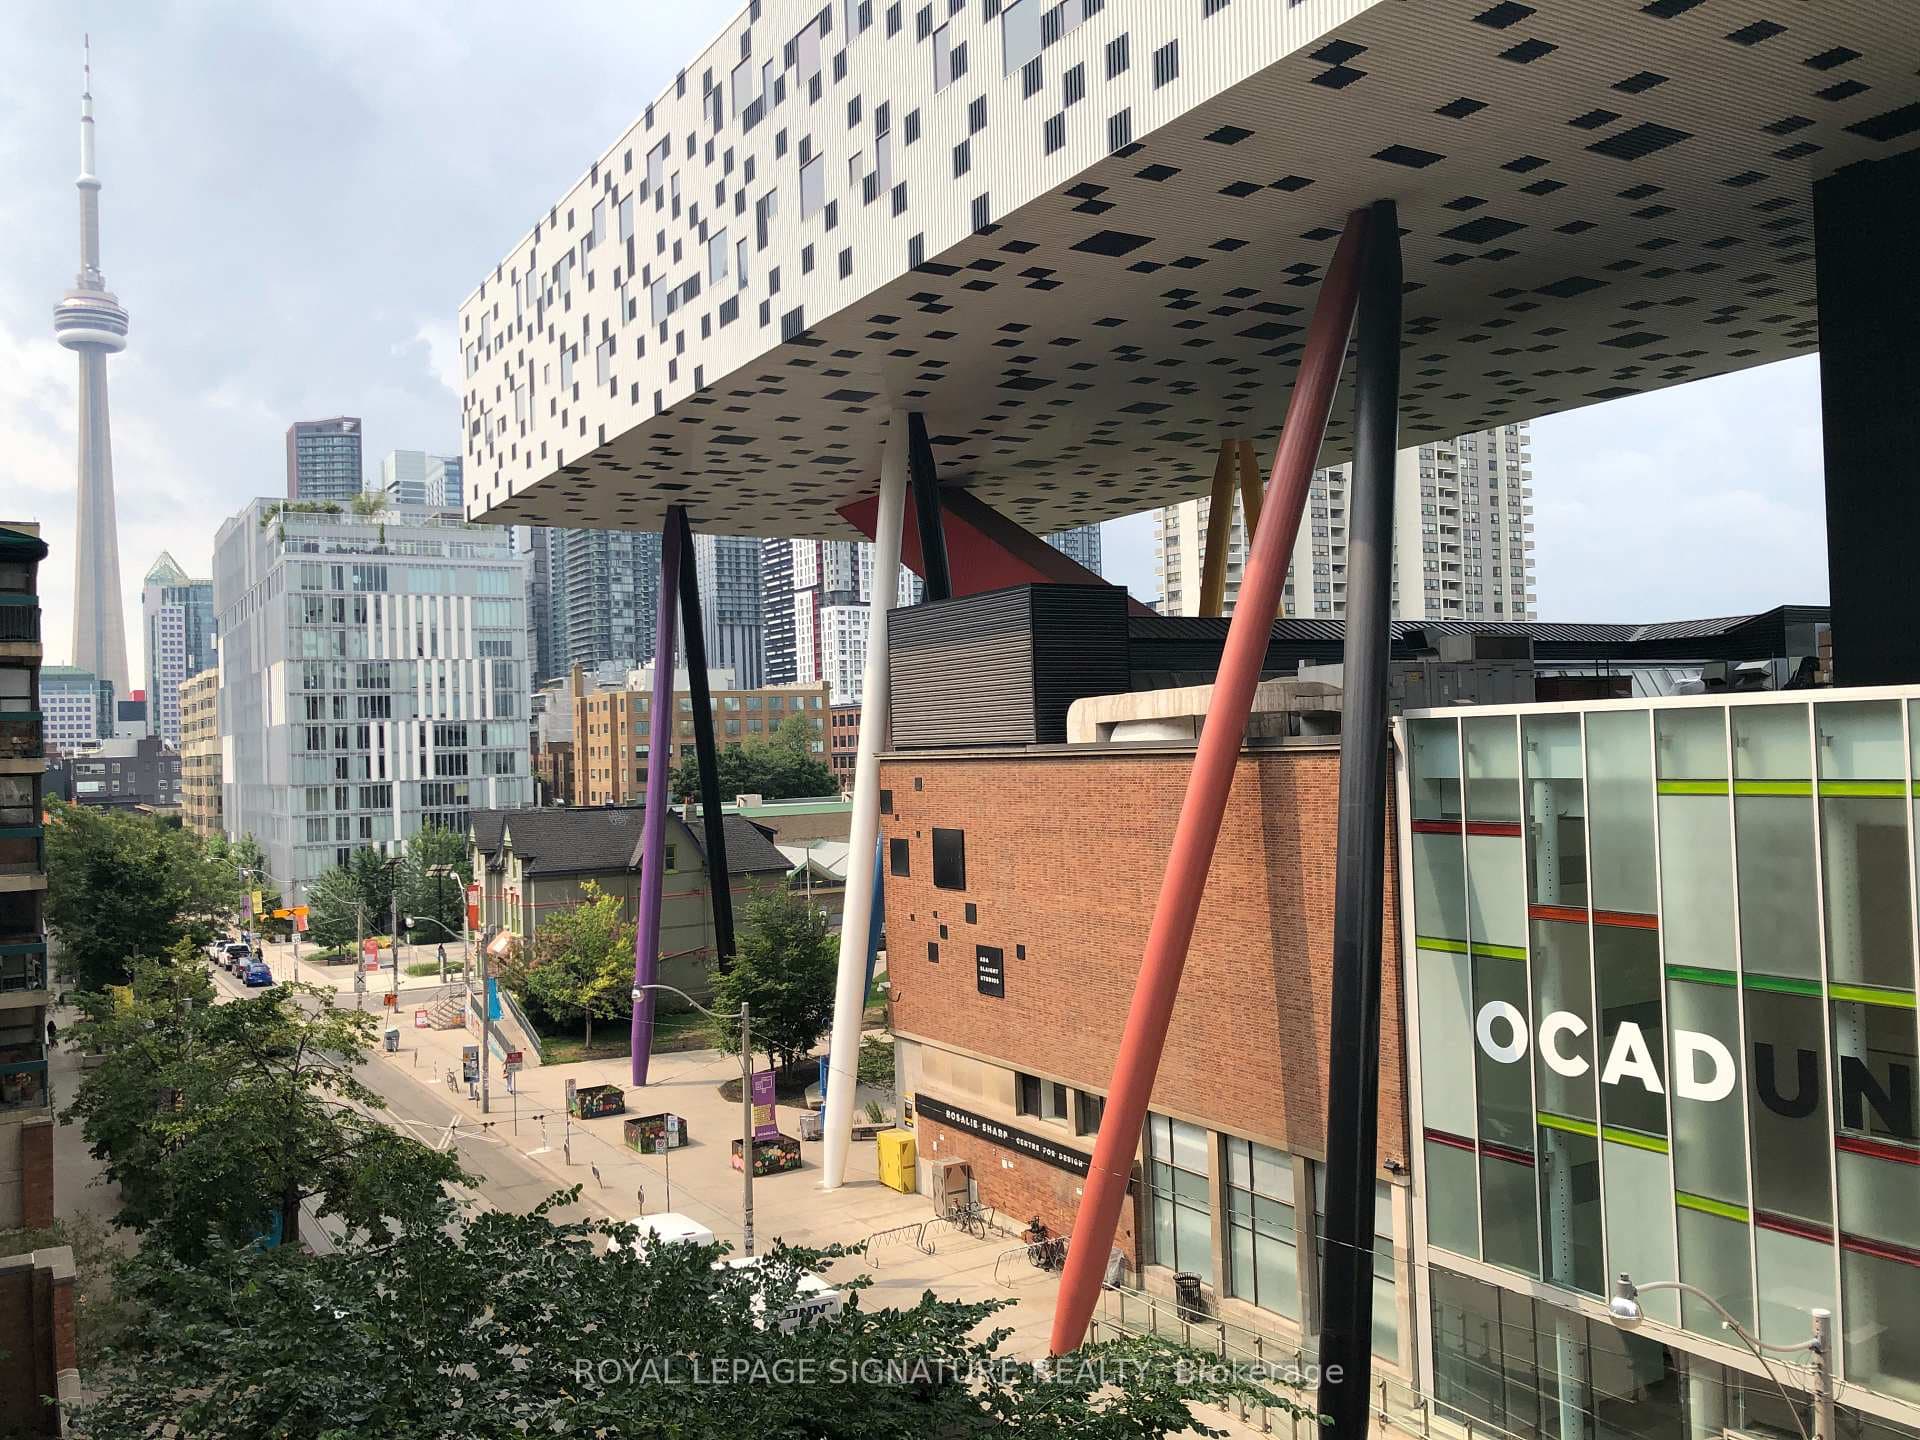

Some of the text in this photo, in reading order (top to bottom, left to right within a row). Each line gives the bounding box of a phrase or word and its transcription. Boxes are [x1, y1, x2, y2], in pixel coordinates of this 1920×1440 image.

[1476, 1000, 1912, 1138] OCAD UN
[945, 1109, 1083, 1168] ROSALIE SHARP CENTRE FOR DESIGN
